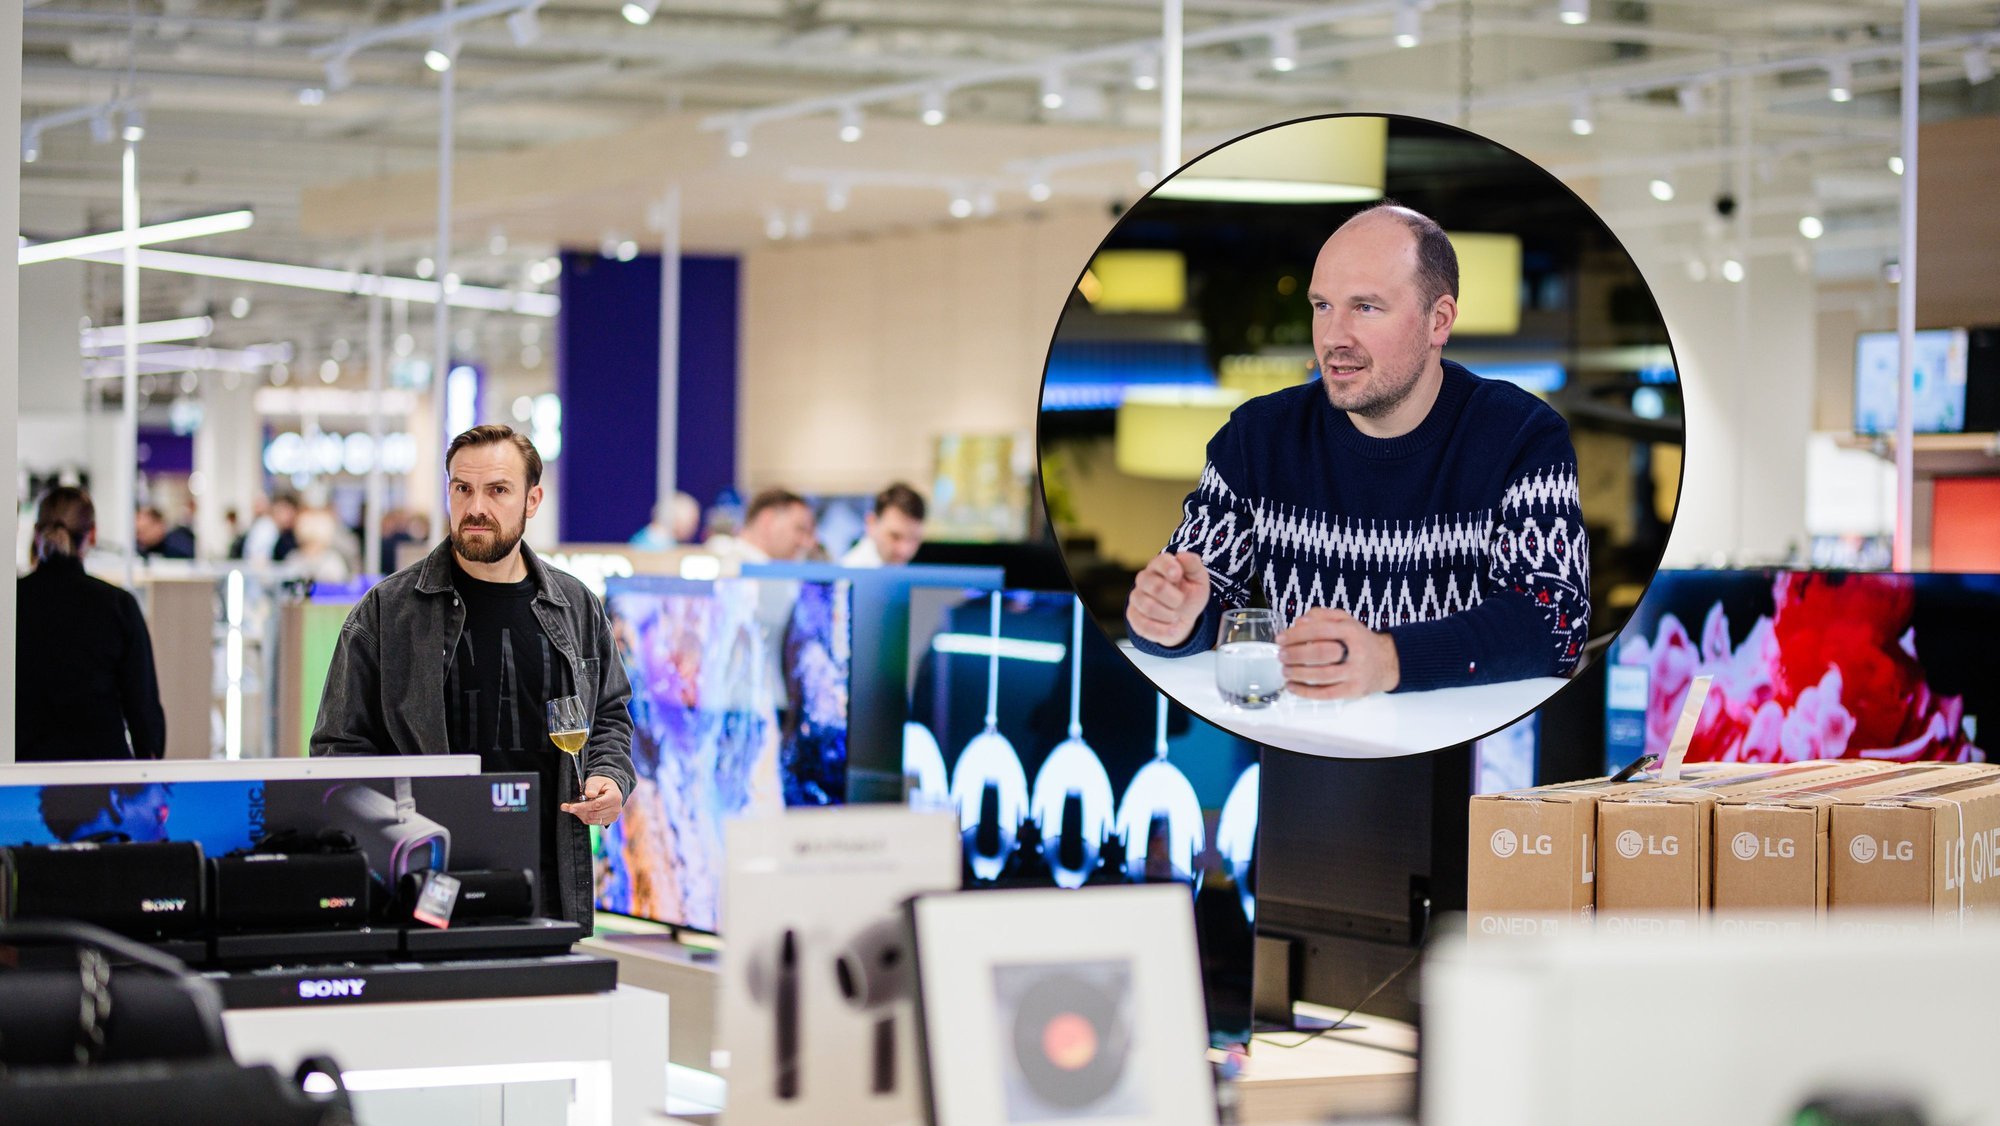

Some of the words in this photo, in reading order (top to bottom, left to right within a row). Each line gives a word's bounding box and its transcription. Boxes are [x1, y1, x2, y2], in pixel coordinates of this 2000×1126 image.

[491, 783, 530, 806] ULT
[1523, 834, 1553, 855] LG
[1648, 835, 1679, 856] LG
[1764, 837, 1795, 858] LG
[1882, 840, 1914, 861] LG
[141, 898, 187, 912] SONY
[319, 898, 356, 909] SONY
[1480, 916, 1537, 935] QNED
[1606, 917, 1665, 935] QNED
[299, 978, 367, 998] SONY
